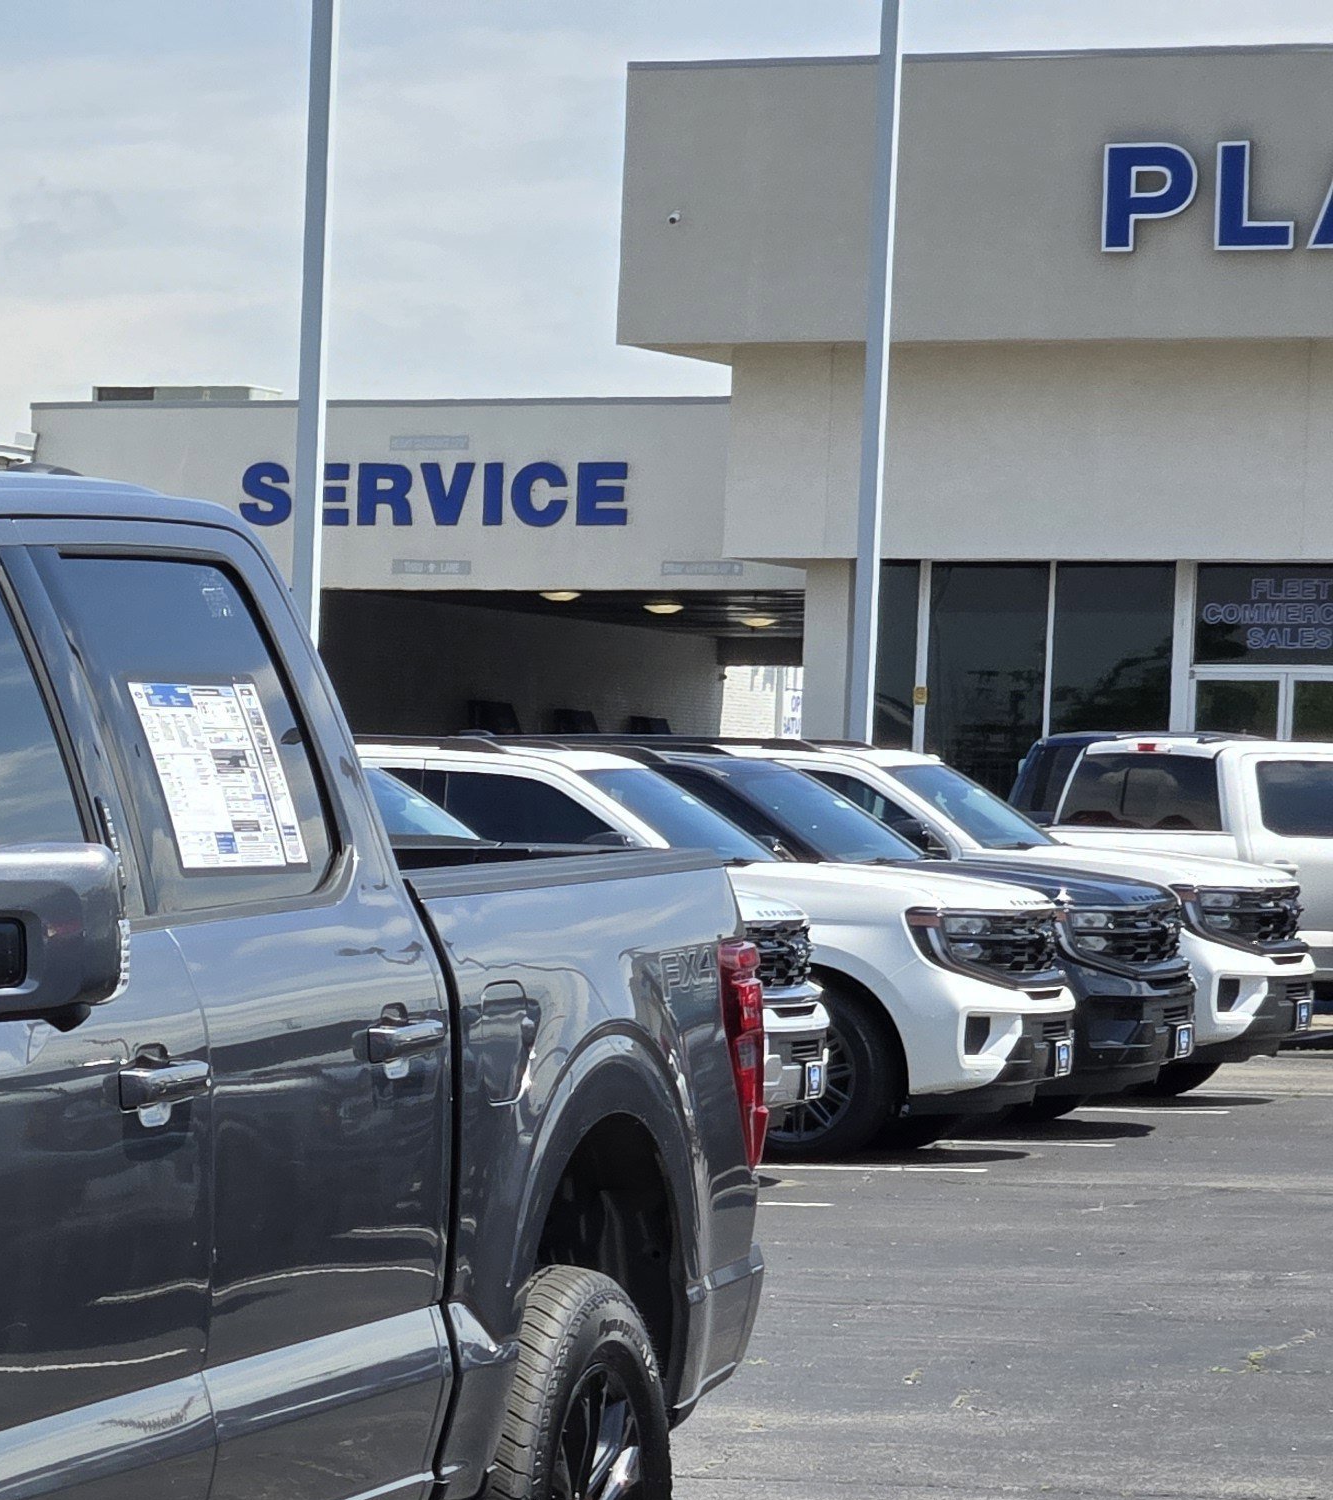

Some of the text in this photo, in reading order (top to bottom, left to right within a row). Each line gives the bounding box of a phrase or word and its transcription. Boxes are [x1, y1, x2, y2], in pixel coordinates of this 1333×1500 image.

[1101, 140, 1333, 252] PL
[239, 461, 628, 527] SERVICE
[1246, 627, 1333, 650] SALES
[659, 945, 717, 1001] FX4
